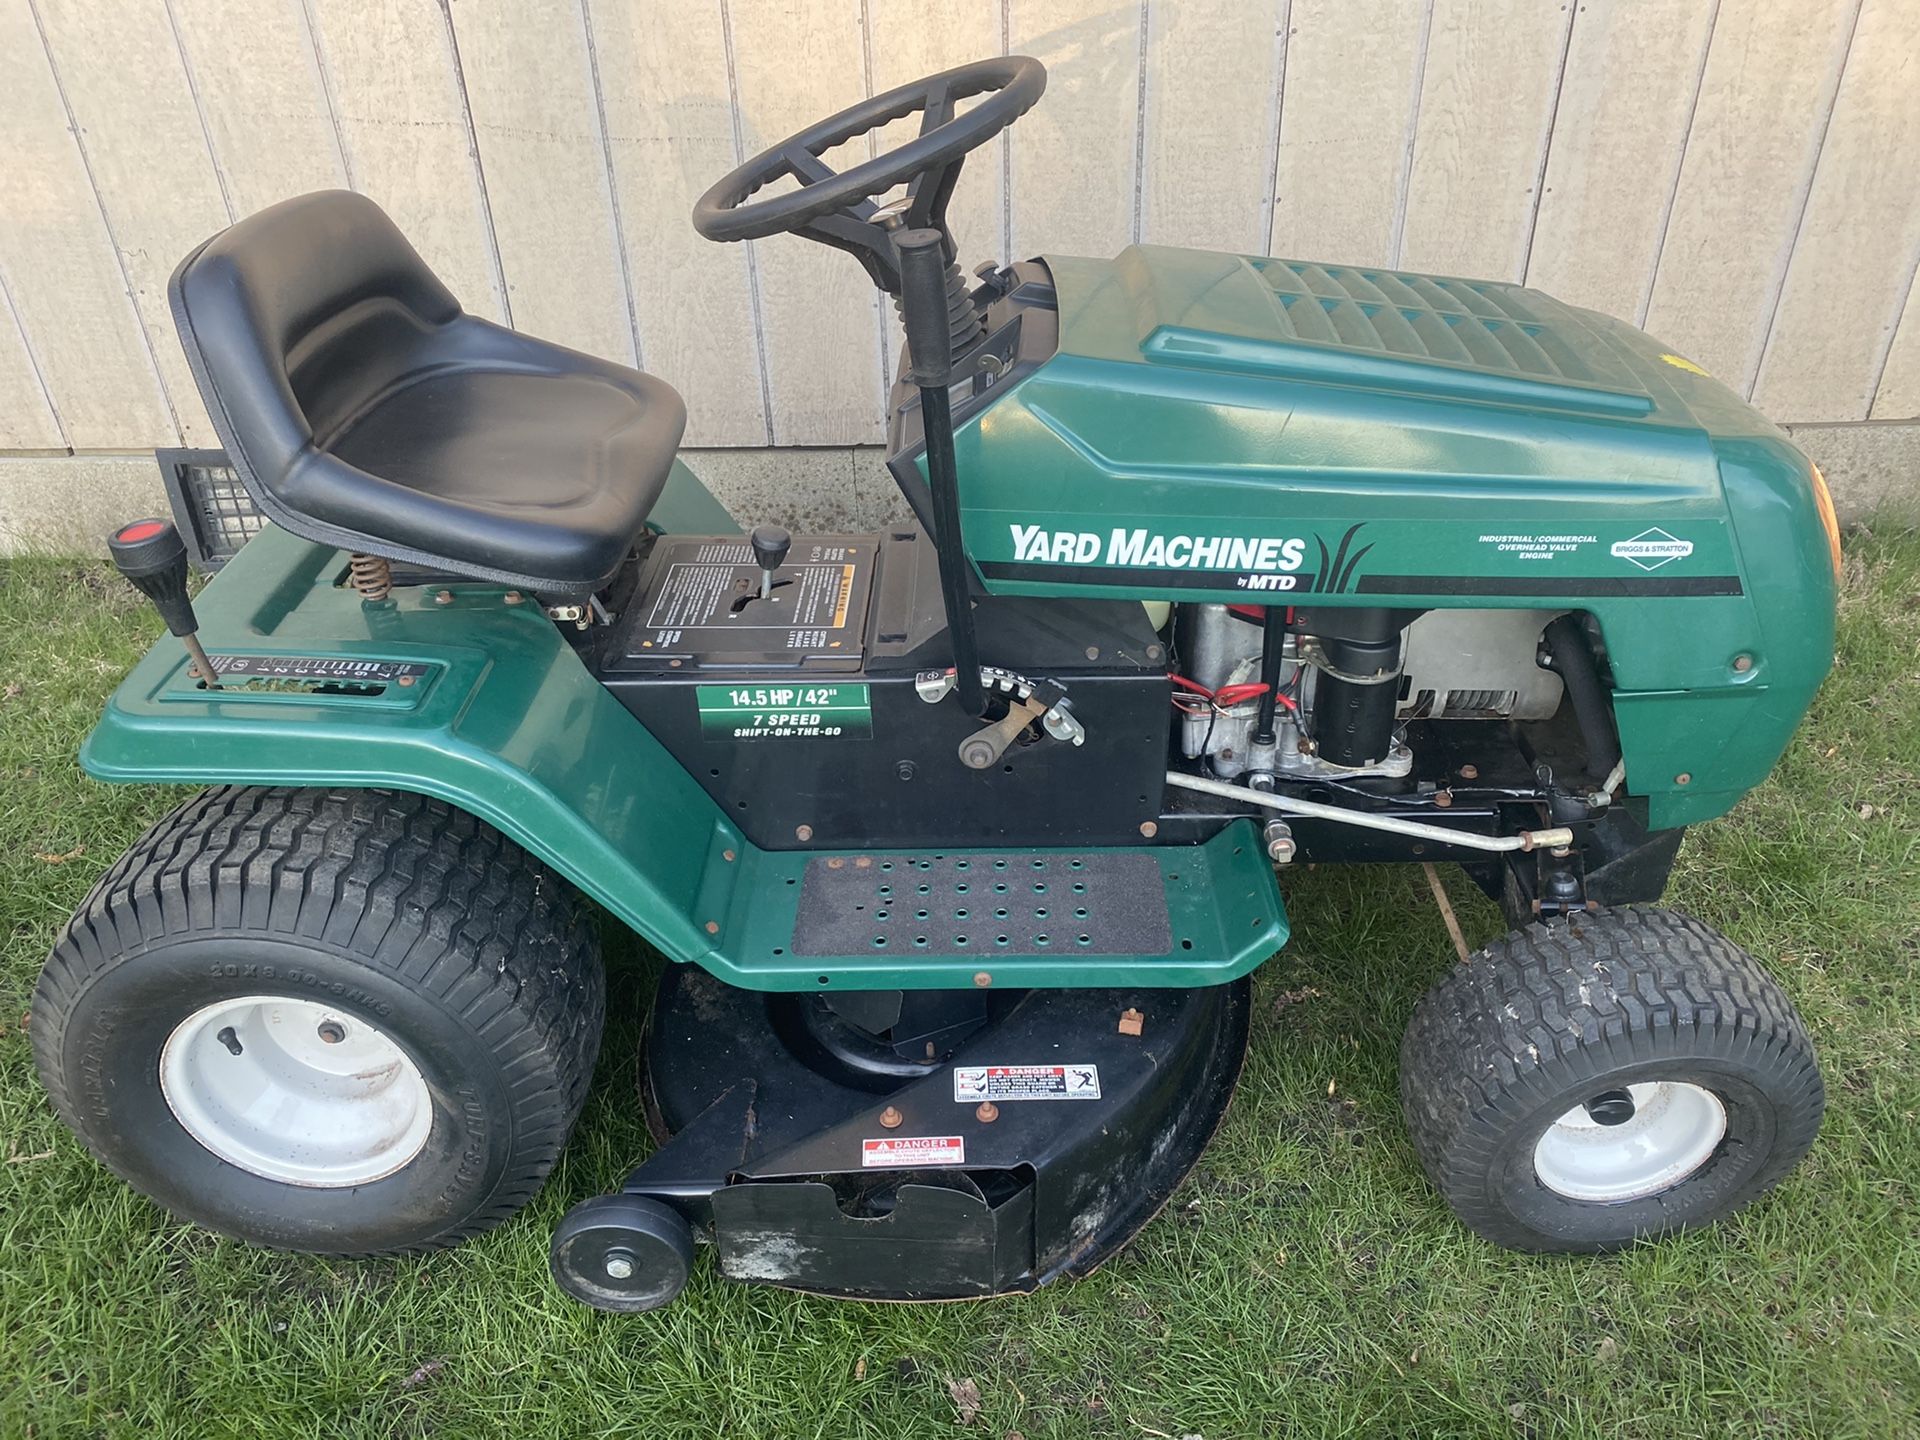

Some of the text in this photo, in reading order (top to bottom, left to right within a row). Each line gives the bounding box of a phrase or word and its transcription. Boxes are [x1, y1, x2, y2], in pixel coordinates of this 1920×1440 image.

[1009, 524, 1305, 571] YARD MACHINES
[1615, 545, 1643, 553] BRIGGS
[1237, 574, 1296, 590] by MTD
[729, 690, 767, 706] 14.5
[753, 714, 821, 726] 7 SPEED
[733, 727, 842, 737] SHIFT-ON-THE-GO
[894, 1140, 948, 1149] DANGER
